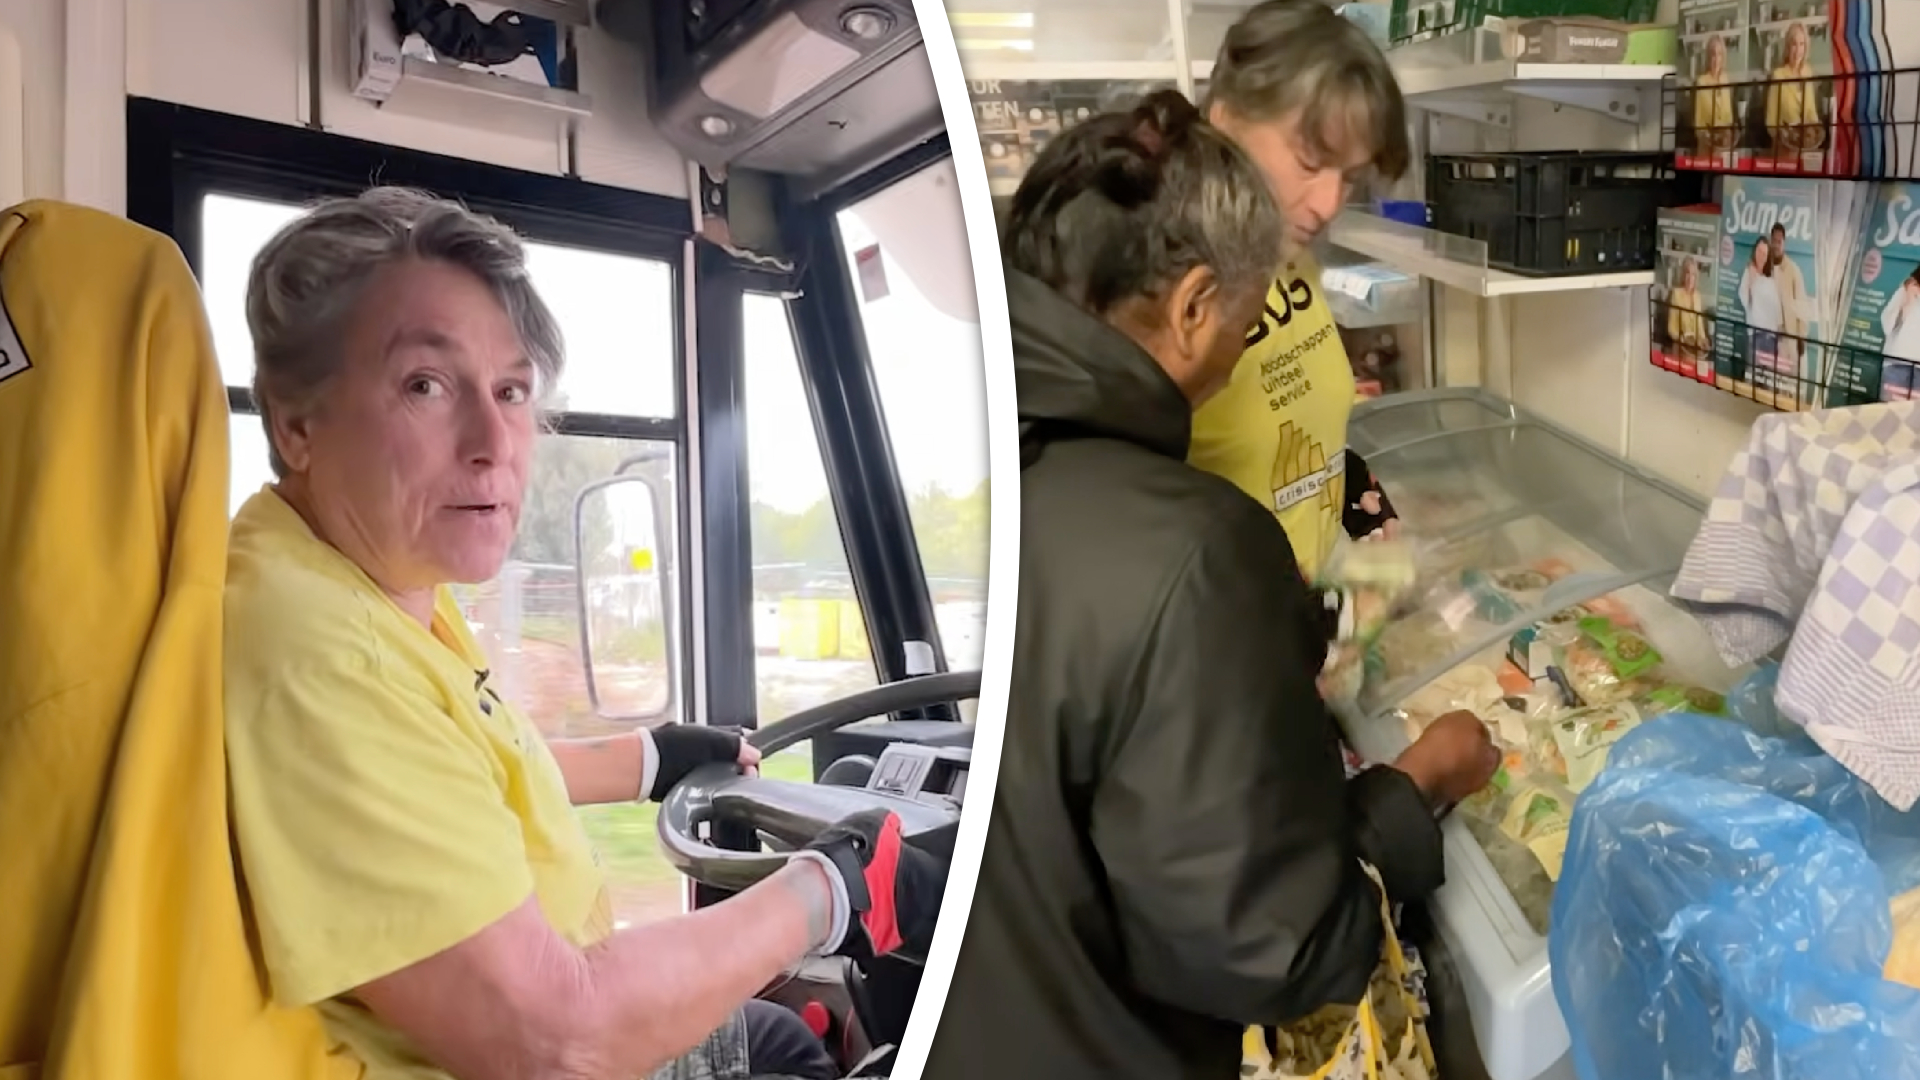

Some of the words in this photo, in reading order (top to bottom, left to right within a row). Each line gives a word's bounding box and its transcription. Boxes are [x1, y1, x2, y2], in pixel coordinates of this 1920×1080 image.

[373, 51, 396, 65] Euro
[1726, 189, 1812, 241] Samen
[1269, 379, 1312, 411] service
